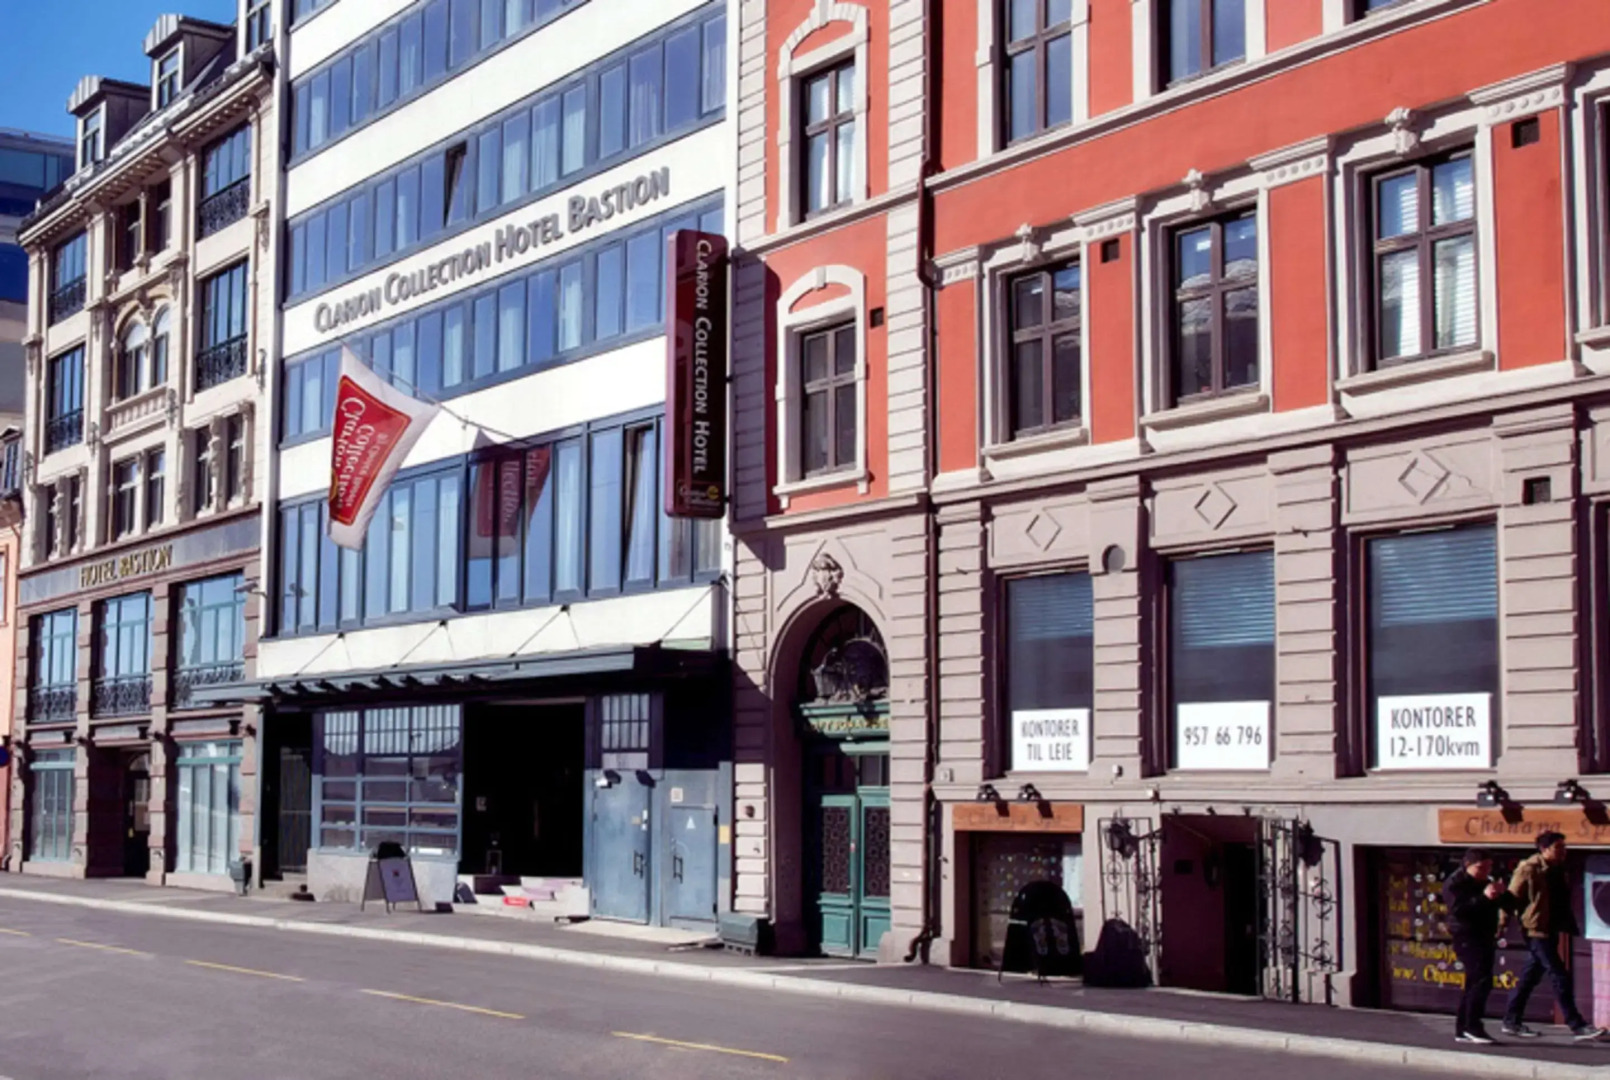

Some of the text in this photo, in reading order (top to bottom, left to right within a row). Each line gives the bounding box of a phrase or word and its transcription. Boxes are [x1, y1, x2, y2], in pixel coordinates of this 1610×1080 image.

[314, 167, 670, 333] CLARION COLLECTION HOTEL BASTION
[694, 239, 712, 474] CLARION COLLECTION HOTEL
[81, 544, 174, 588] HOTEL BASTION
[1021, 719, 1080, 738] KONTORER
[1391, 705, 1476, 729] KONTORER
[1184, 725, 1262, 746] 957 66 796
[1390, 734, 1480, 757] 12-170kvm
[1027, 741, 1073, 761] TIL LEIE
